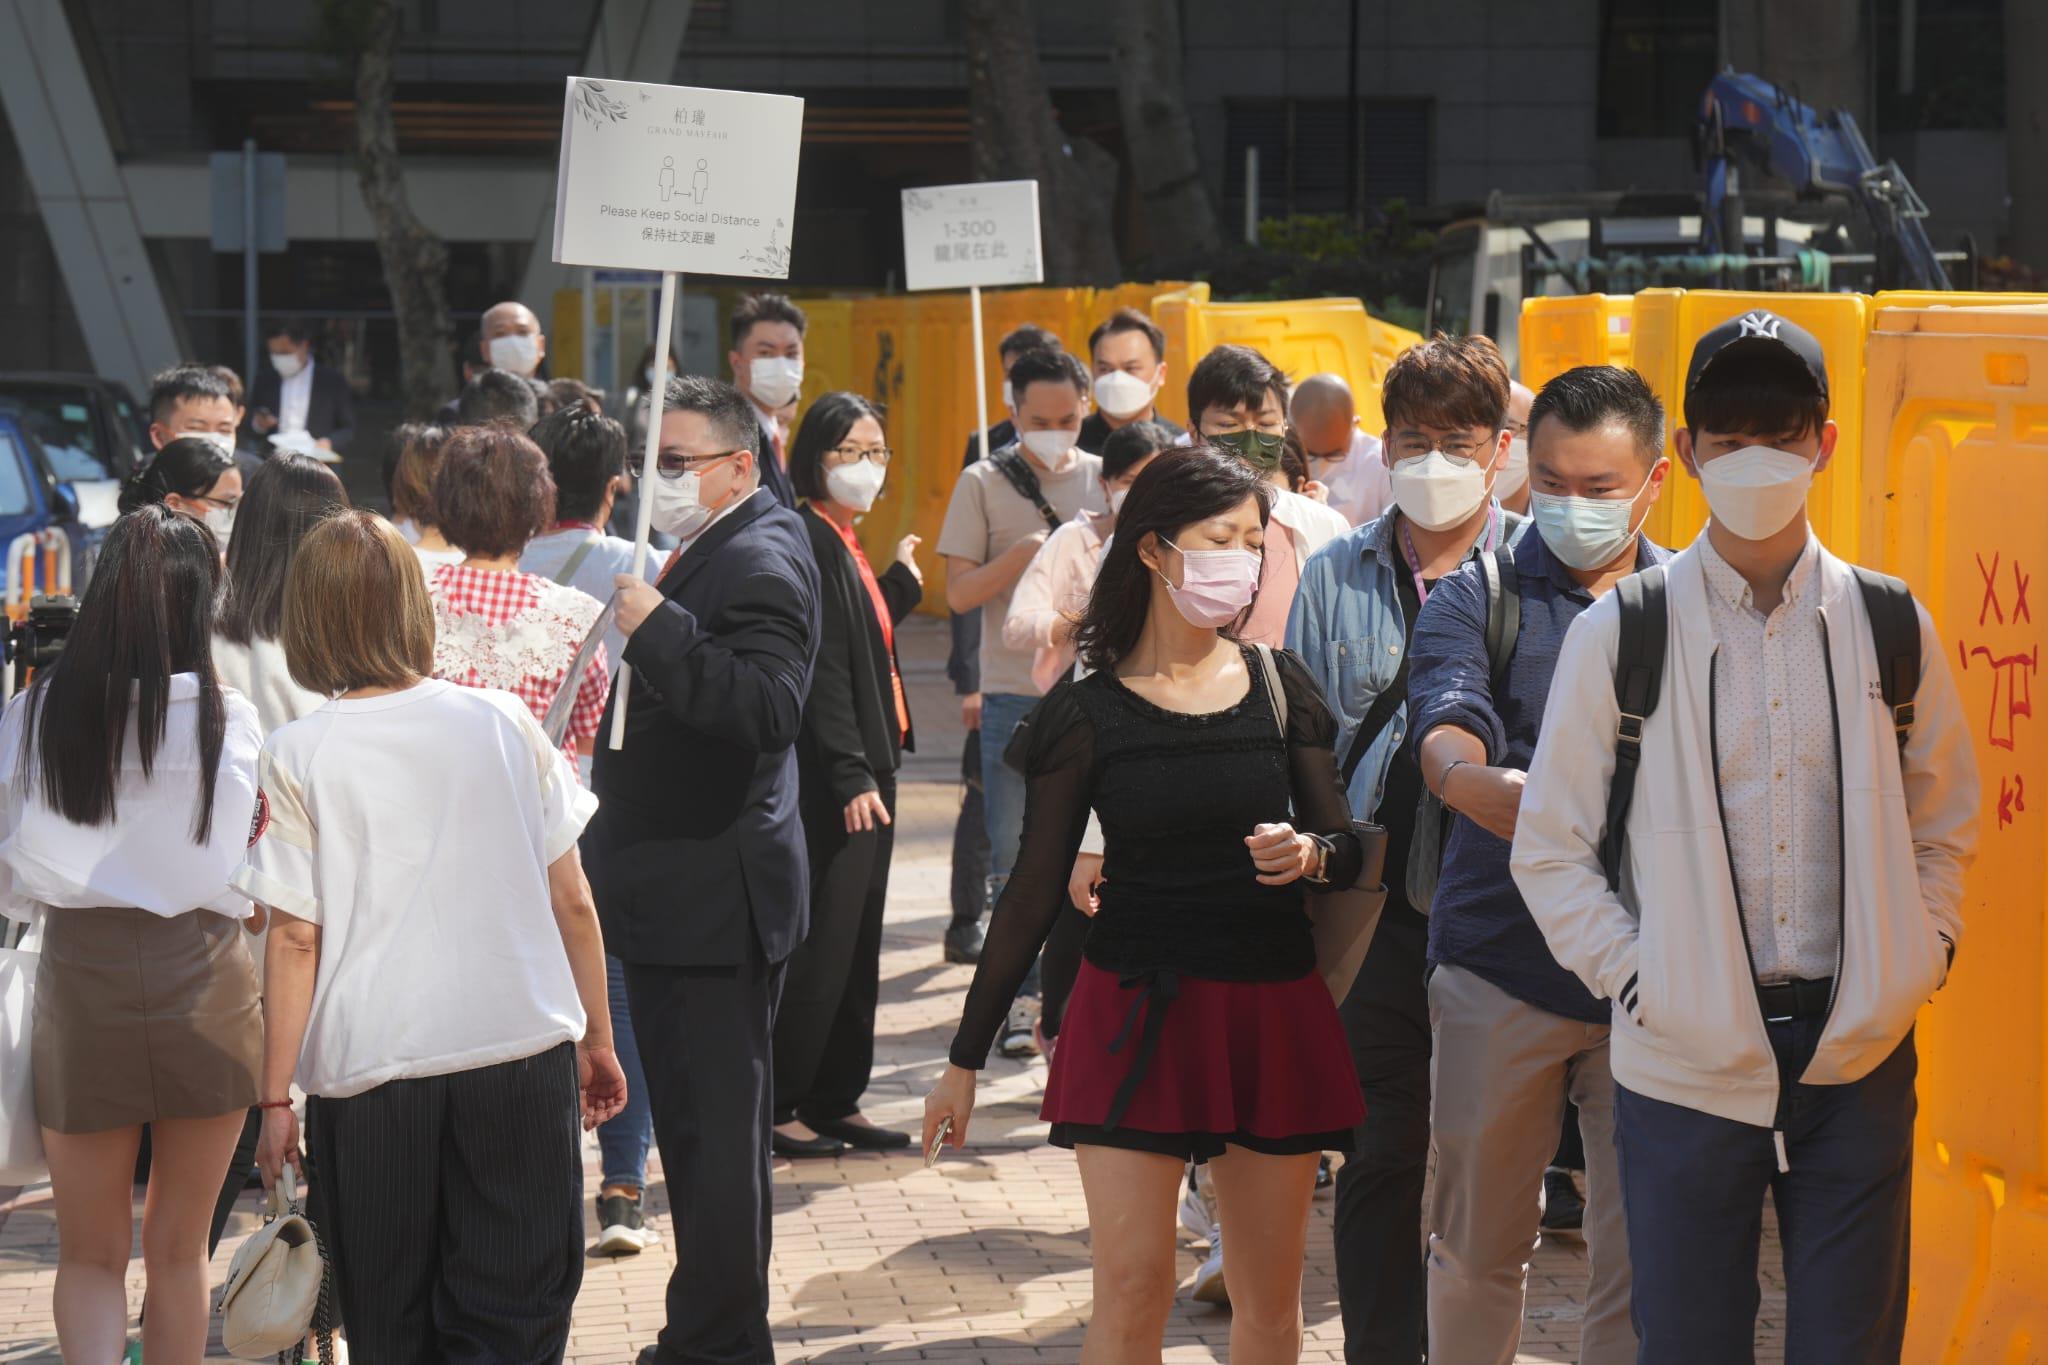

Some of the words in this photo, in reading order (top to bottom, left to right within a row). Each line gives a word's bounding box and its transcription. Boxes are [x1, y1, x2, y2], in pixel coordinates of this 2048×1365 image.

[647, 126, 682, 138] GRAND
[686, 128, 728, 140] MAYFAIR
[600, 204, 637, 218] Please
[641, 208, 670, 223] Keep
[674, 210, 708, 223] Social
[712, 213, 760, 227] Distance
[641, 227, 716, 245] 保持社交距離
[943, 220, 997, 238] 1-300
[1739, 312, 1781, 339] NY
